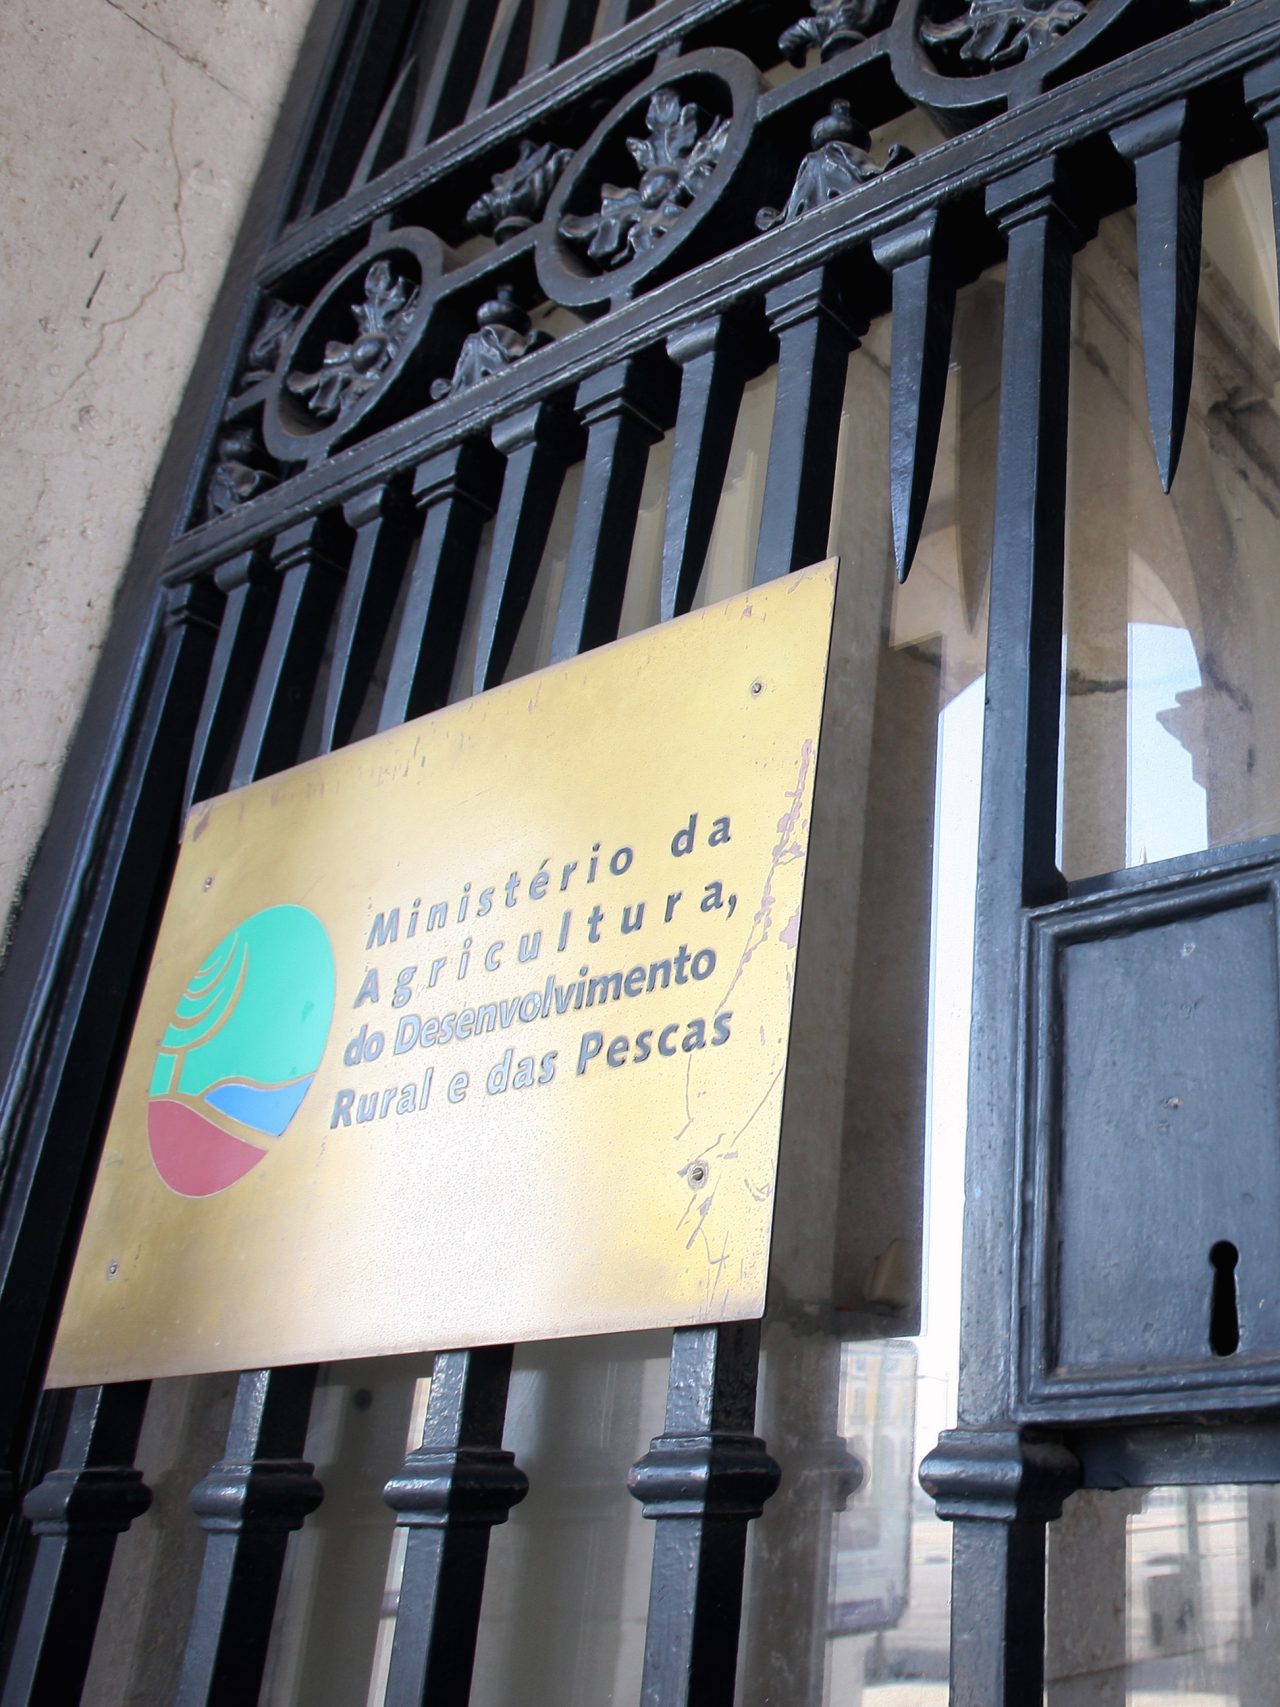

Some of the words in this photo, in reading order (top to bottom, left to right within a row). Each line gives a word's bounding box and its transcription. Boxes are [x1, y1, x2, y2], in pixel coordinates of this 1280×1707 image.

[353, 878, 737, 1009] Agricultura,
[366, 841, 633, 950] Ministério
[670, 813, 732, 858] da
[343, 1024, 384, 1067] do
[394, 944, 717, 1057] Desenvolvimento
[330, 1067, 434, 1129] Rural
[447, 1072, 469, 1104] e
[486, 1045, 558, 1096] das
[576, 1010, 734, 1076] Pescas
